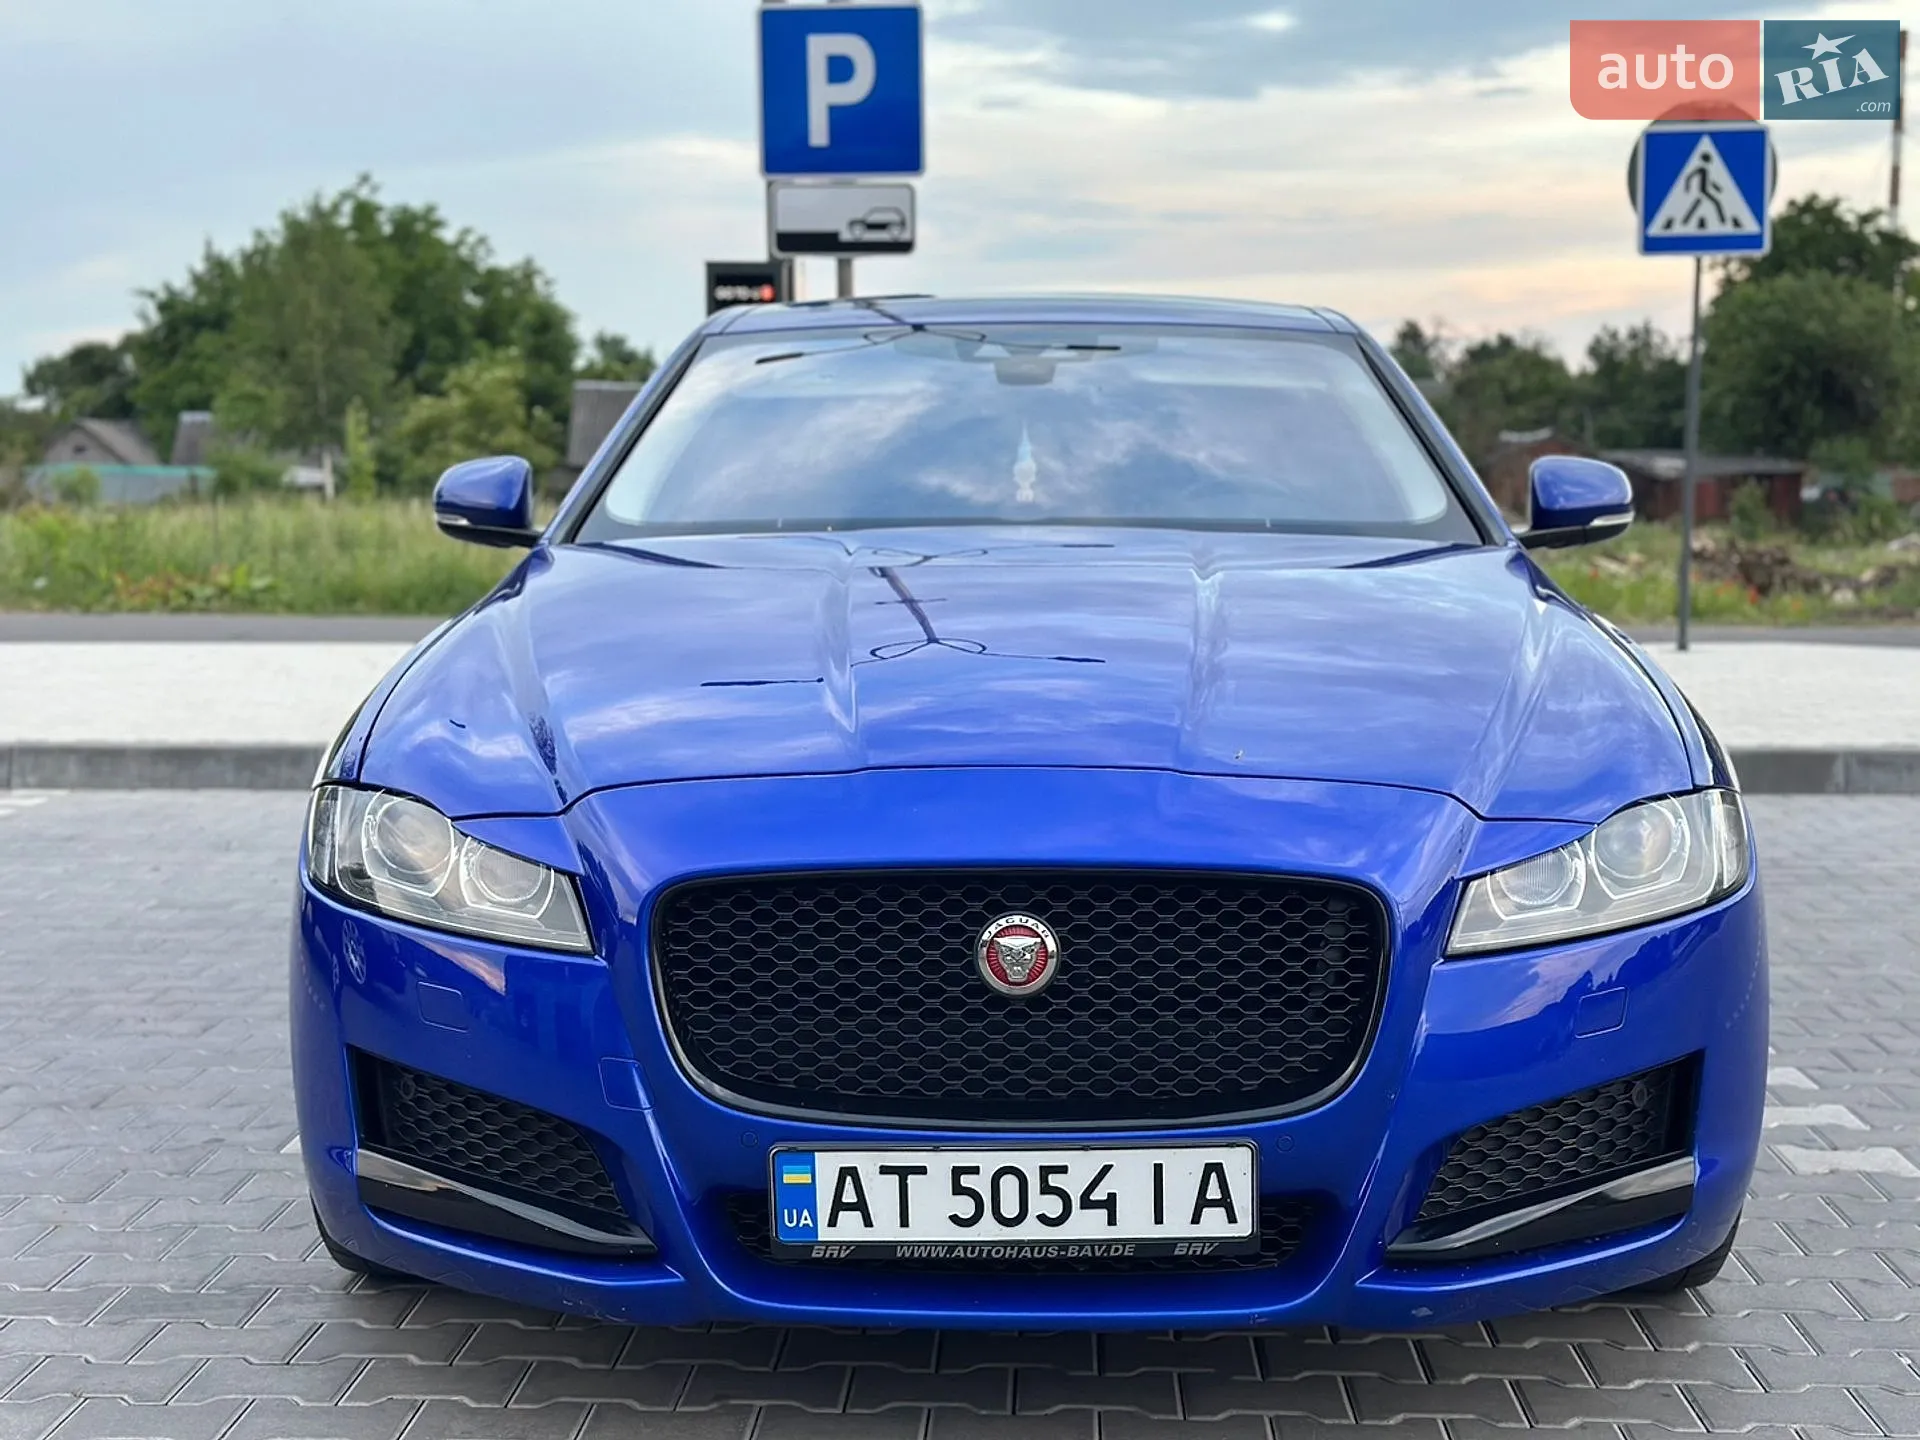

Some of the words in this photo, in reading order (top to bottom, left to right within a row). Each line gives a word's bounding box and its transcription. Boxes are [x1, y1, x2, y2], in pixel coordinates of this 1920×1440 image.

[806, 33, 877, 149] P
[985, 917, 1050, 940] JAGUAR
[826, 1165, 928, 1228] AT
[948, 1164, 1118, 1228] 5054
[783, 1208, 814, 1228] UA
[811, 1245, 855, 1259] BAV
[896, 1243, 1136, 1260] WWW.AUTOHAUS-BAV.DE
[1173, 1242, 1219, 1256] BAV
